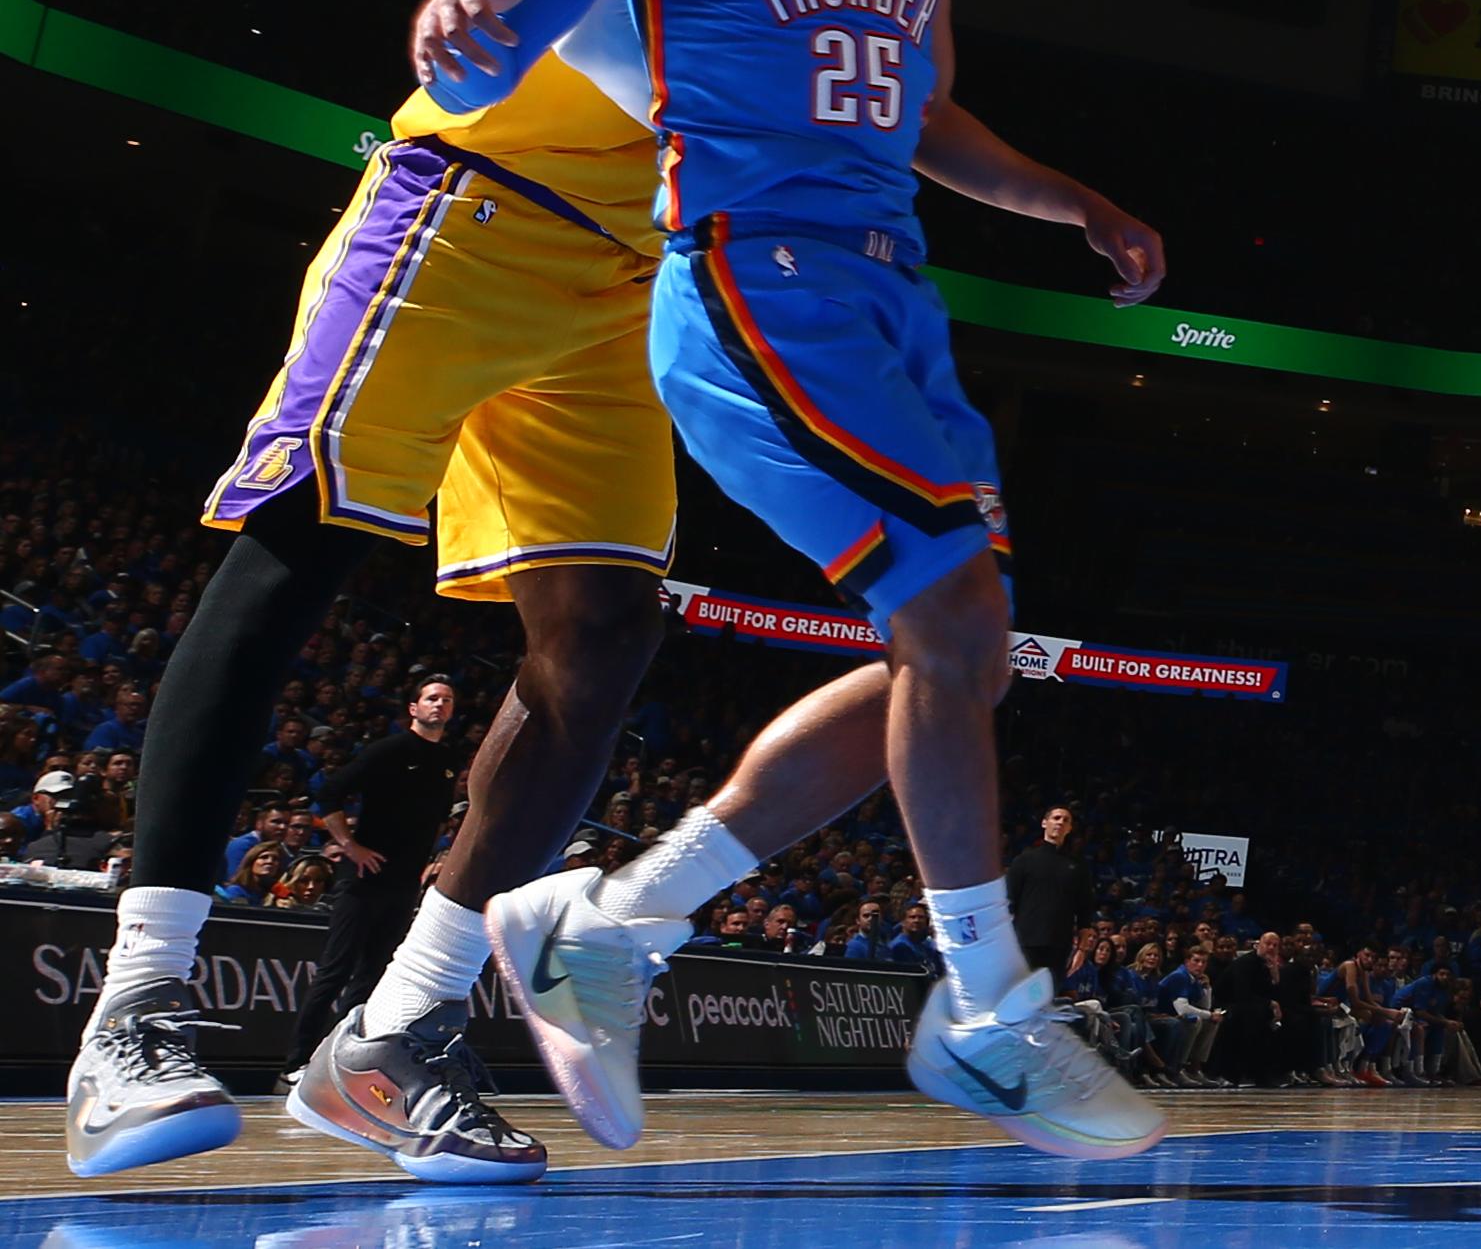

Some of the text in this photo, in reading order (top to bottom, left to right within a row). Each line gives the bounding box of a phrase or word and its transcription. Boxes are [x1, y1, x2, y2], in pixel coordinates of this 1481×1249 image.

[811, 28, 902, 131] 25
[1171, 321, 1236, 350] Sprite
[698, 601, 886, 645] BUILT FOR GREATNESS
[1008, 654, 1049, 670] HOME
[1071, 653, 1262, 687] BUILT FOR GREATNESS!
[32, 943, 304, 1013] SARDAY
[688, 984, 793, 1043] peacock
[809, 979, 906, 1016] SATURDAY
[815, 1015, 914, 1049] NIGHTLIVE
